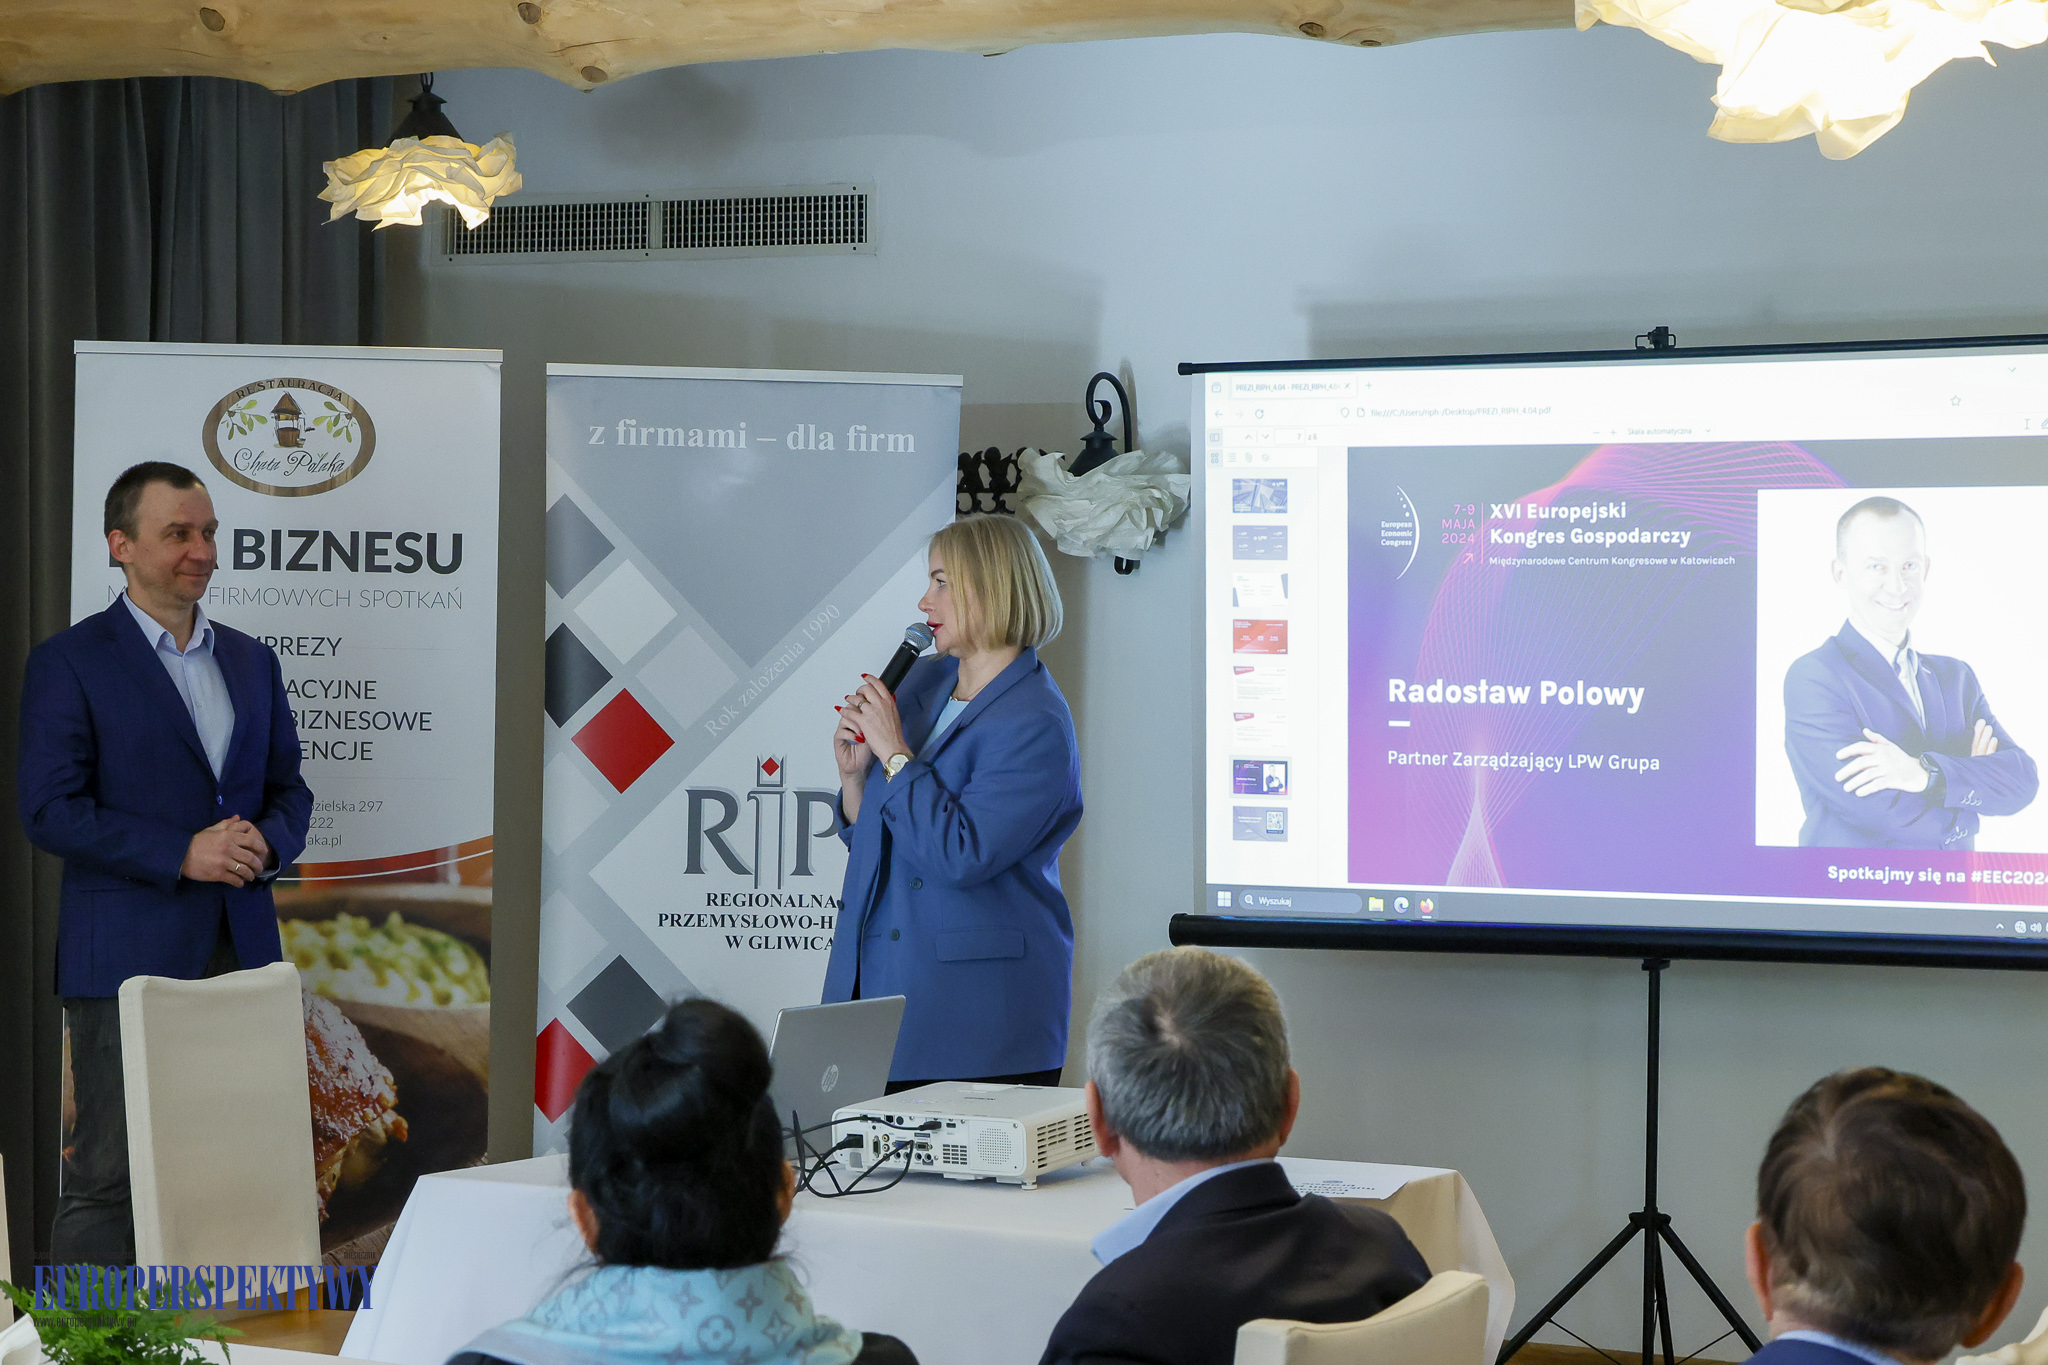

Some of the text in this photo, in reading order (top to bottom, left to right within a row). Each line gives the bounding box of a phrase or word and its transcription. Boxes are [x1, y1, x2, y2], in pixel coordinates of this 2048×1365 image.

[235, 378, 343, 402] RESTAURACJA
[588, 426, 605, 445] z
[616, 419, 747, 449] firmami
[787, 424, 835, 451] dla
[847, 425, 916, 453] firm
[1628, 426, 1692, 437] Skala automatyczna
[233, 448, 281, 476] Chata
[1454, 504, 1475, 515] 7-9
[1490, 502, 1627, 523] XVI Europejski
[1381, 520, 1412, 531] European
[1442, 518, 1476, 530] MAJA
[1381, 530, 1412, 539] Economic
[1381, 539, 1412, 548] Congress
[1442, 533, 1476, 544] 2024
[1490, 528, 1692, 549] Kongres Gospodarczy
[233, 529, 463, 575] BIZNESU
[1489, 556, 1566, 569] Międzynarodowe
[1568, 556, 1609, 566] Centrum
[1611, 556, 1669, 568] Kongresowe
[1680, 556, 1735, 566] Katowicach
[208, 586, 463, 610] FIRMOWYCH SPOTKAŃ
[803, 604, 840, 642] 1990
[256, 636, 342, 656] PREZY
[286, 679, 377, 699] ACYJNE
[704, 641, 805, 737] Rok założenia
[1389, 679, 1645, 714] Radosław Polowy
[1388, 751, 1660, 774] Partner Zarządzający LPW Grupa
[358, 801, 383, 812] 297
[307, 834, 342, 848] aka.pl
[1828, 866, 1914, 885] Spotkajmy
[1918, 868, 1942, 885] się
[1946, 872, 1966, 883] na
[706, 893, 838, 909] REGIONALNA
[1258, 896, 1292, 908] Wyszukaj
[658, 913, 834, 930] PRZEMYSŁOWO-H
[725, 935, 744, 950] W
